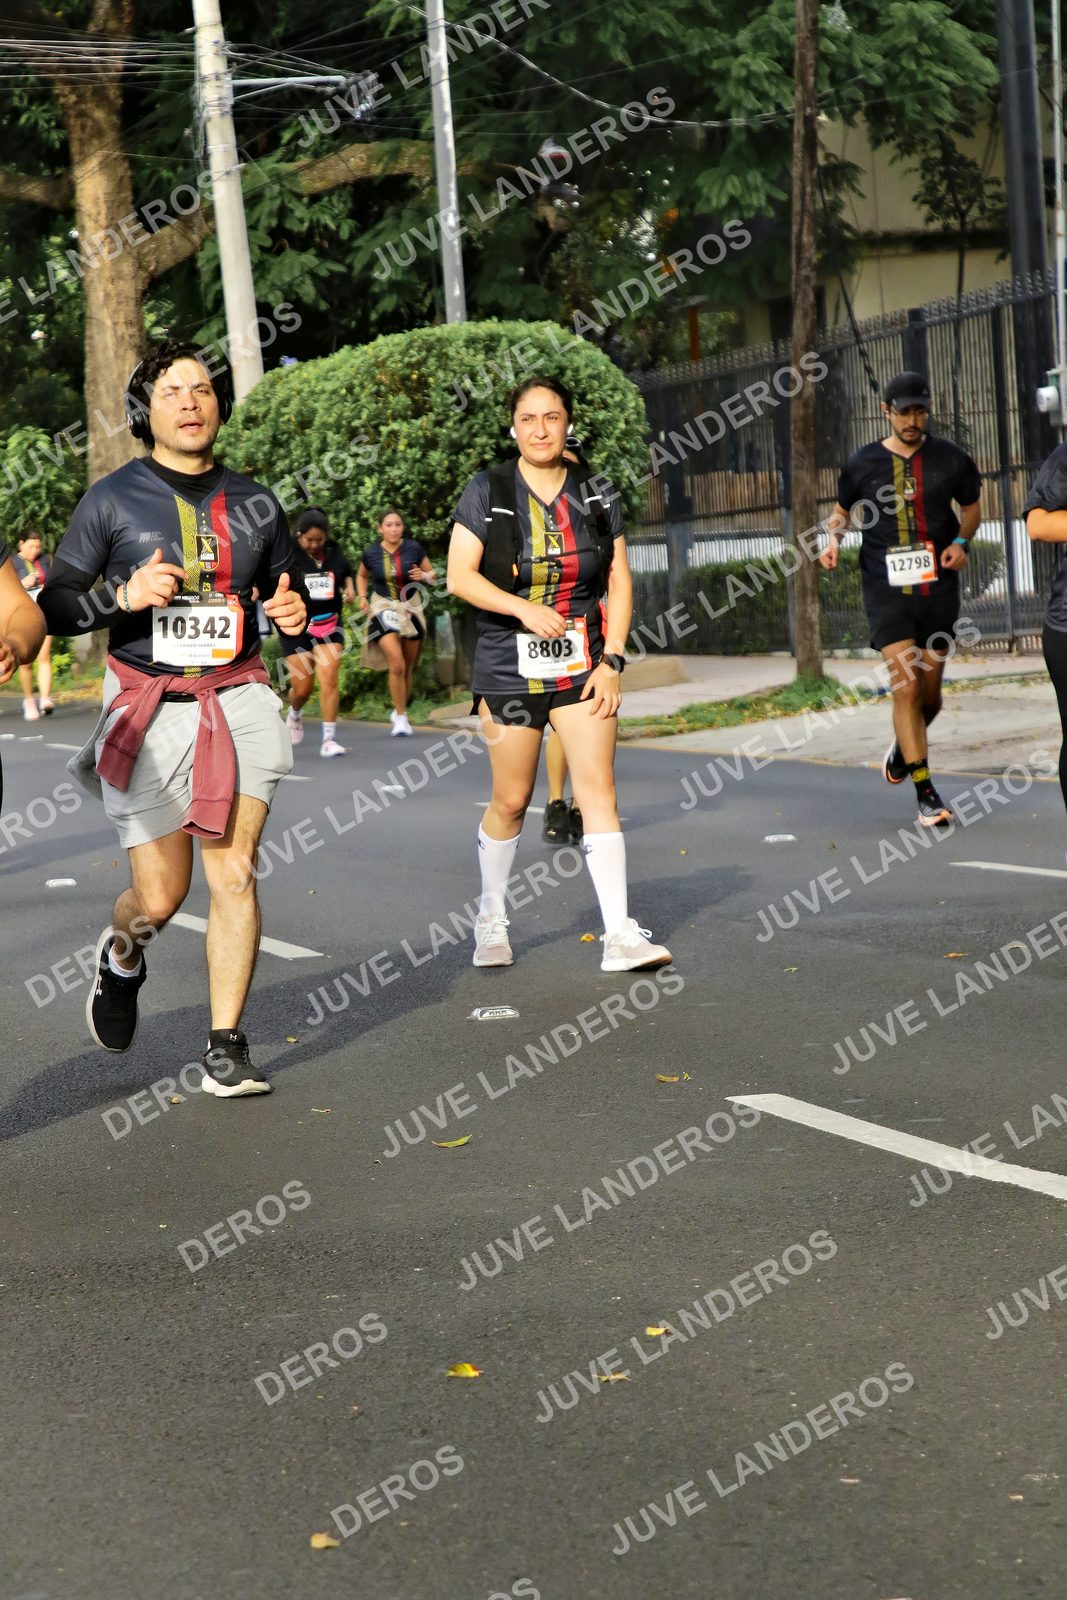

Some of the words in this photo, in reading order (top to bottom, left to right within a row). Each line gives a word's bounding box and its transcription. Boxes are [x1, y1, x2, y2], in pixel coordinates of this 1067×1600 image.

[890, 555, 931, 572] 12798
[157, 615, 231, 639] 10342
[527, 638, 573, 659] 8803
